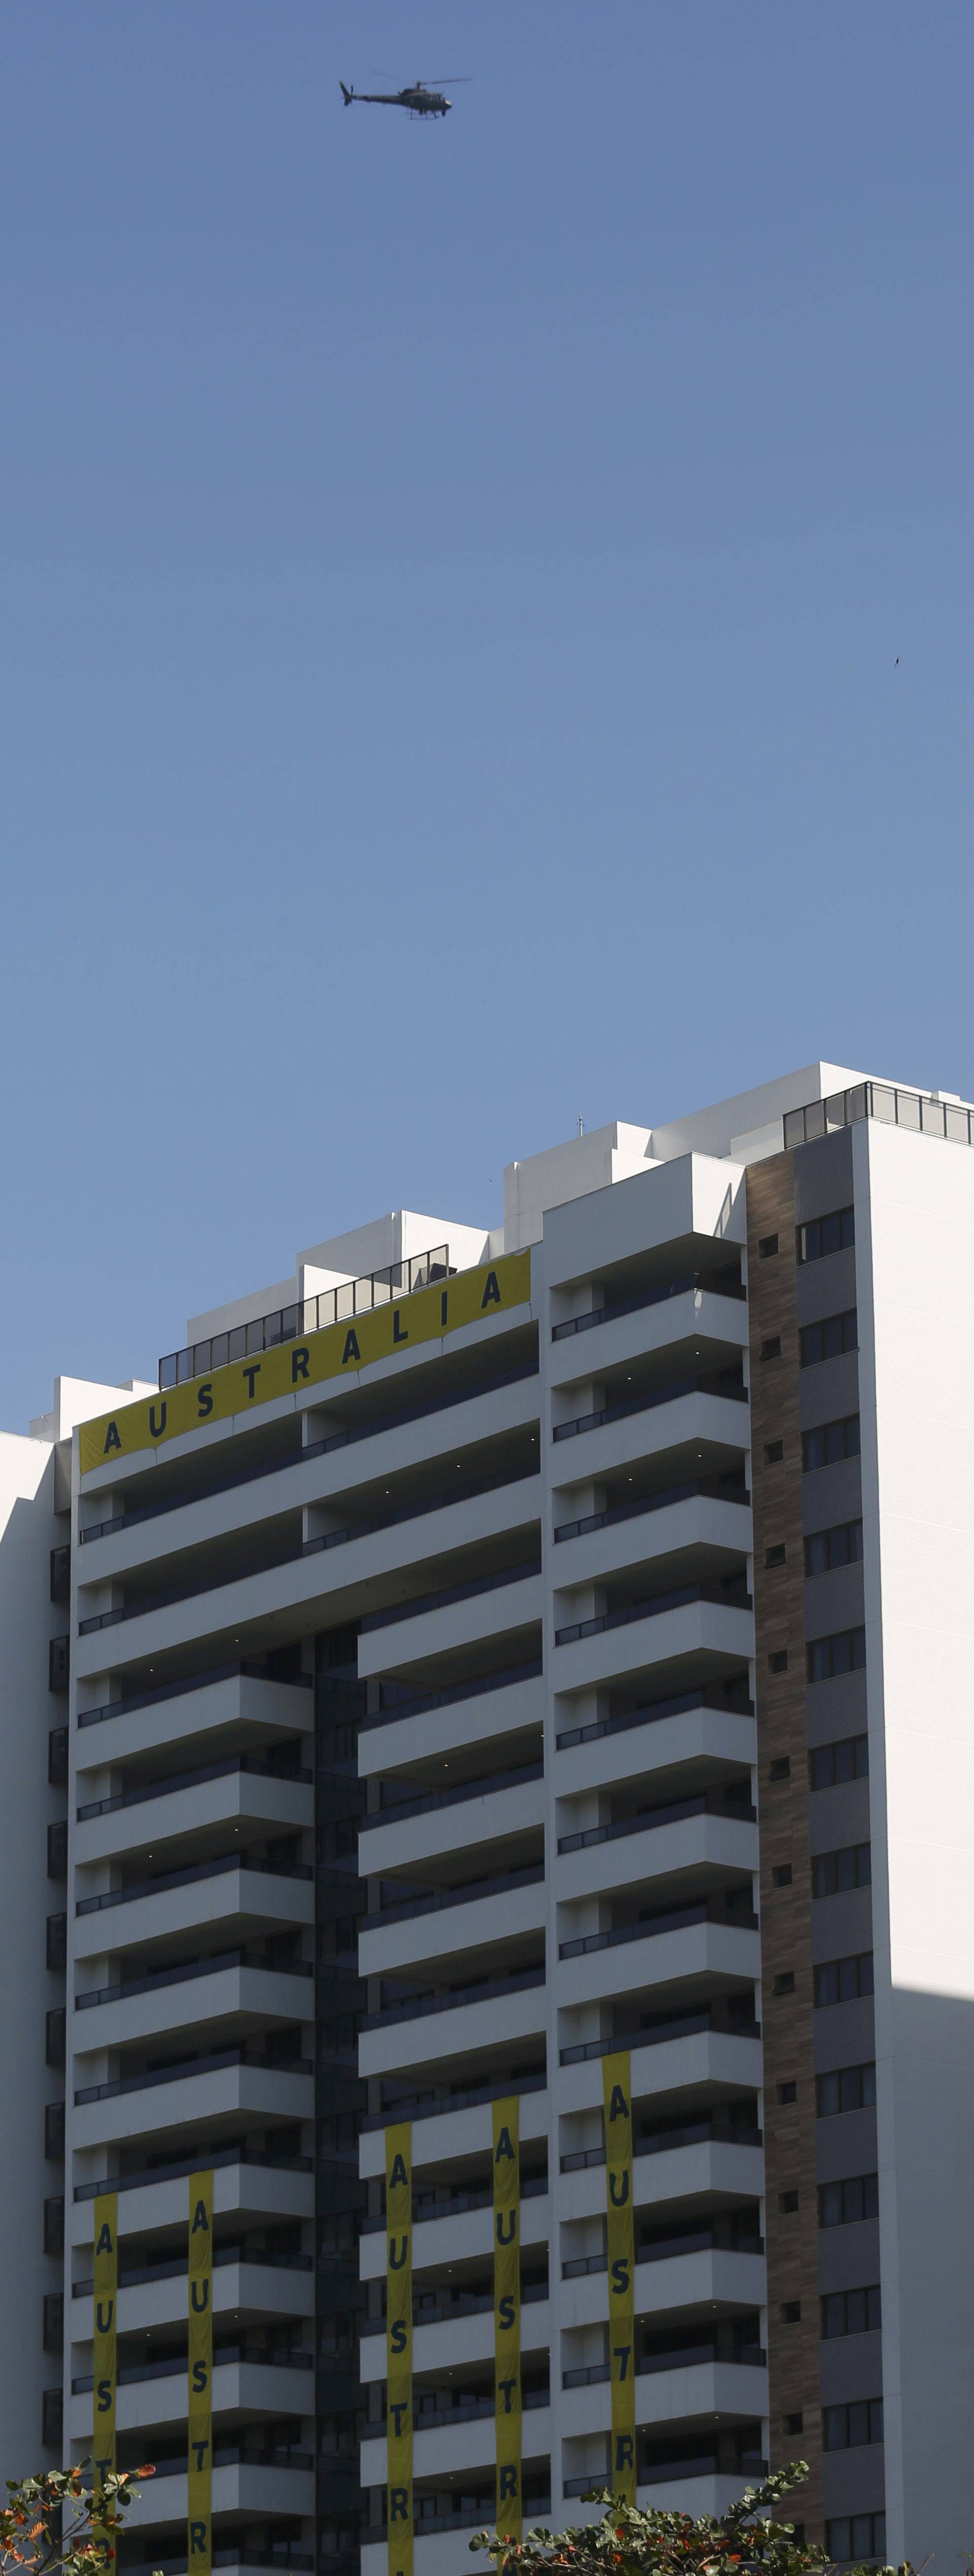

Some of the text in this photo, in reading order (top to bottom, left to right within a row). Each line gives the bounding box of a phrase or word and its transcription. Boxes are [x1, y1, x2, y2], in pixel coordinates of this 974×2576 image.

[103, 1271, 501, 1454] AUSTRALIA
[190, 2200, 209, 2554] AUSTR
[389, 2154, 409, 2576] AUSTR
[609, 2085, 634, 2508] AUSTR
